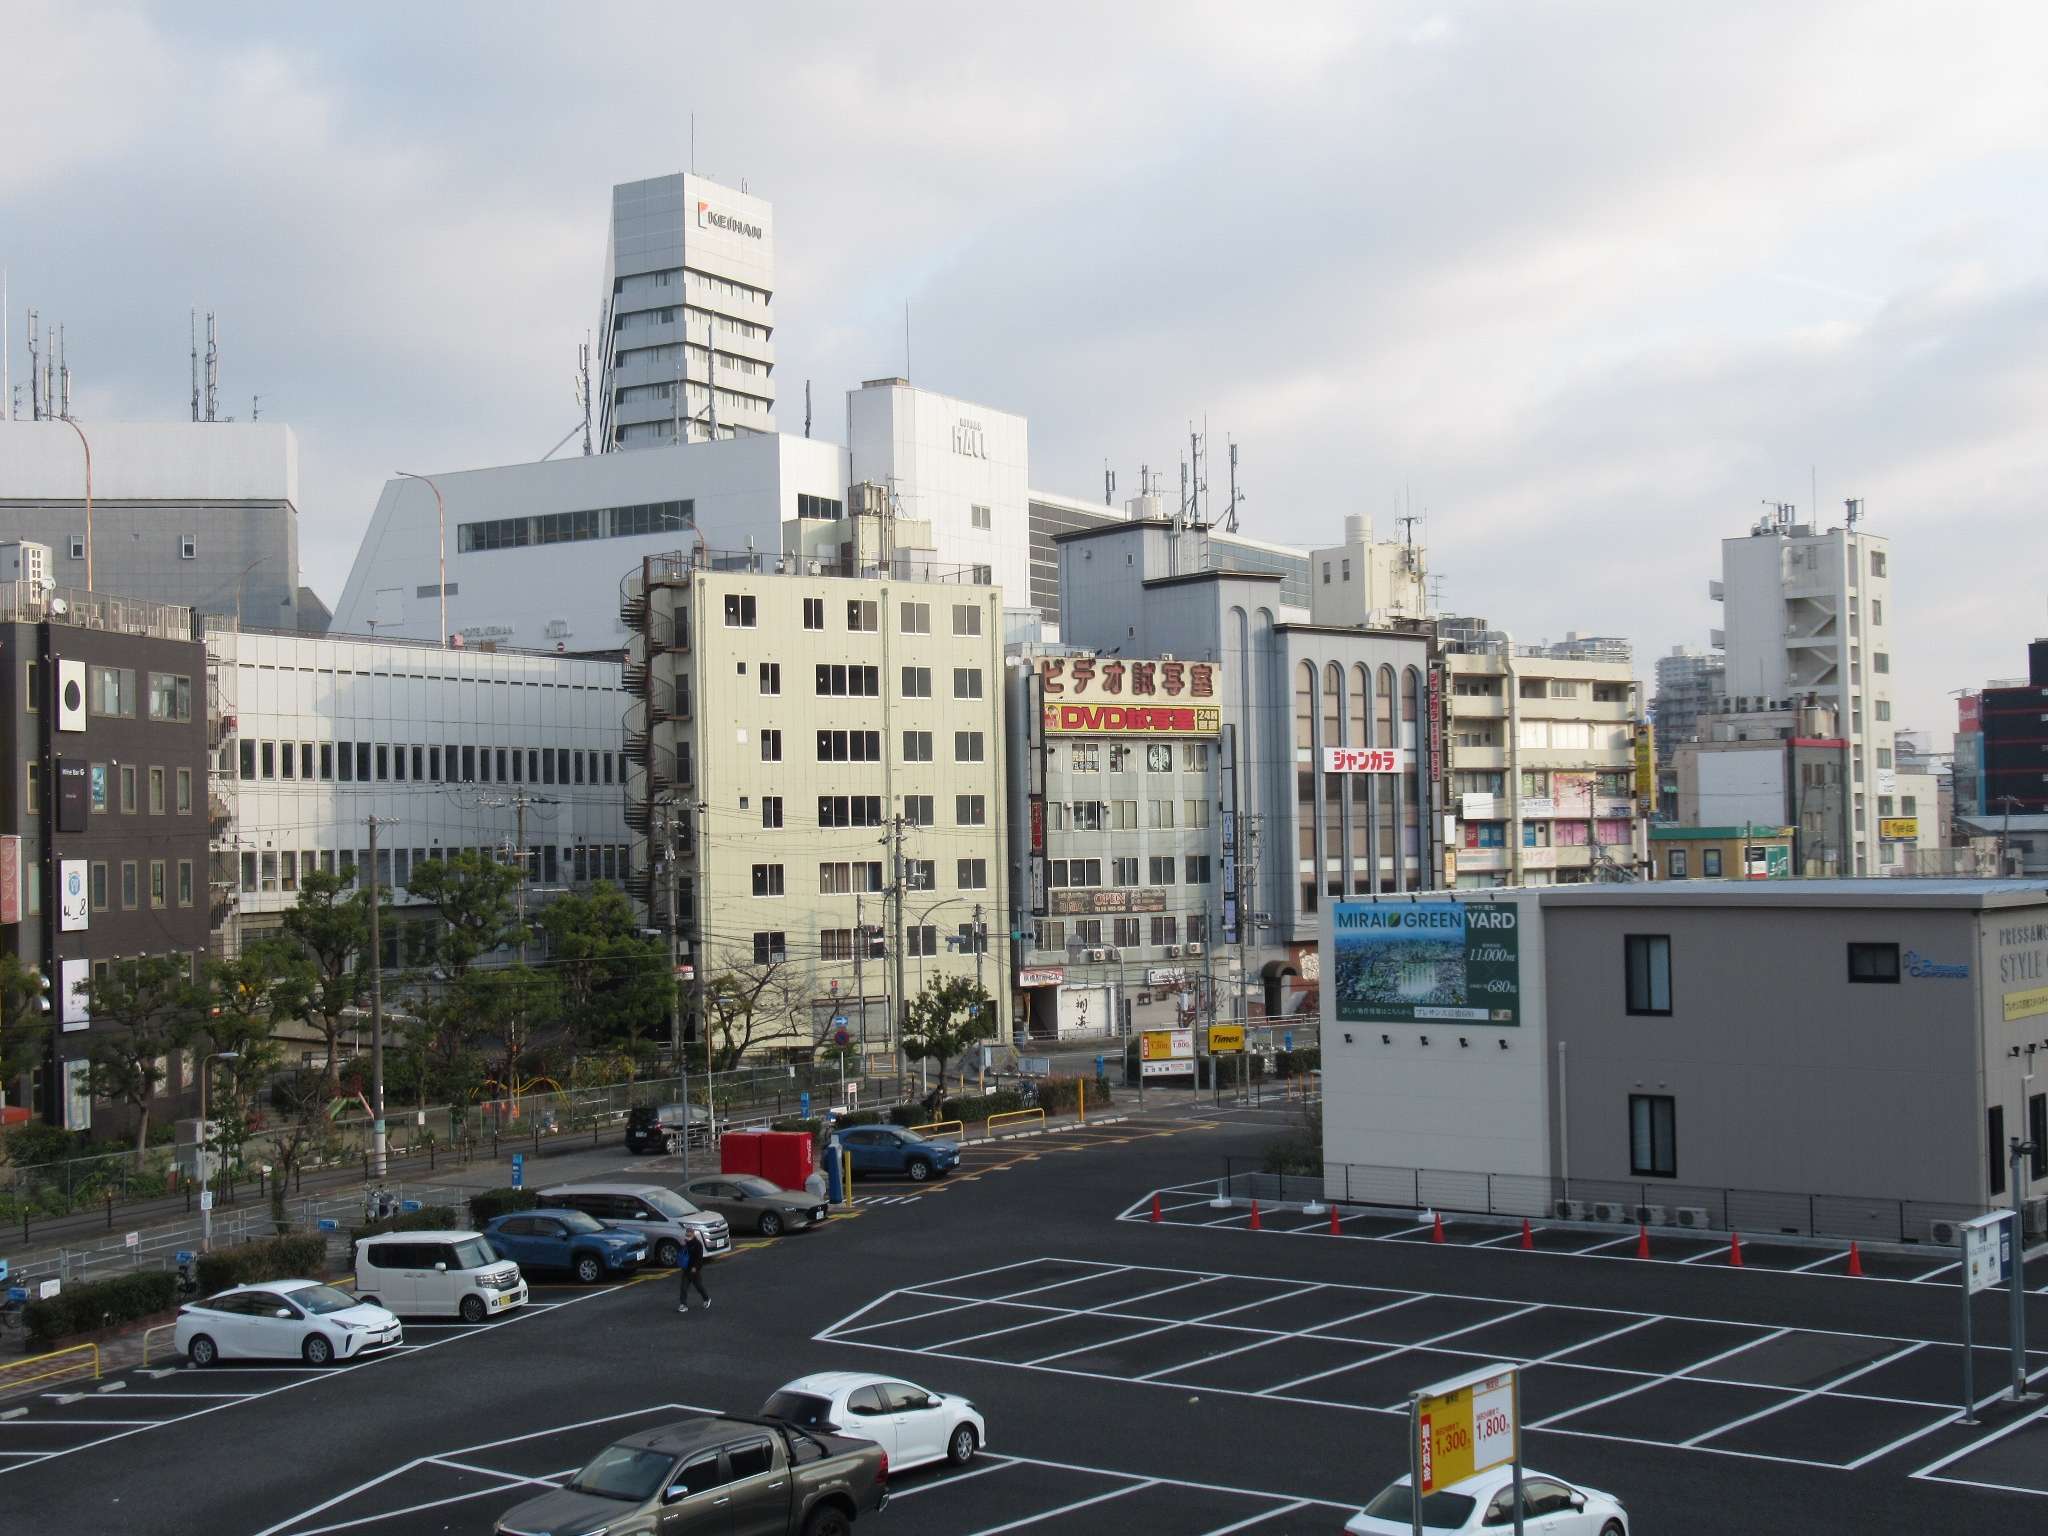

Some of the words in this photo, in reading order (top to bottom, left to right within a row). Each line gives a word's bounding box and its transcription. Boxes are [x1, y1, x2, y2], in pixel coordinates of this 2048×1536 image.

[707, 211, 762, 240] KEIHAN
[1042, 658, 1214, 697] ビデオ試写室
[1333, 750, 1395, 771] ジャンカラ
[1093, 892, 1126, 905] OPEN
[1338, 912, 1386, 928] MIRAI
[1405, 912, 1462, 928] GREEN
[1466, 912, 1516, 929] YARD
[2000, 951, 2041, 983] STYLE
[1213, 1034, 1240, 1044] Times
[1477, 1415, 1507, 1441] 1,800
[1435, 1429, 1467, 1457] 1,300
